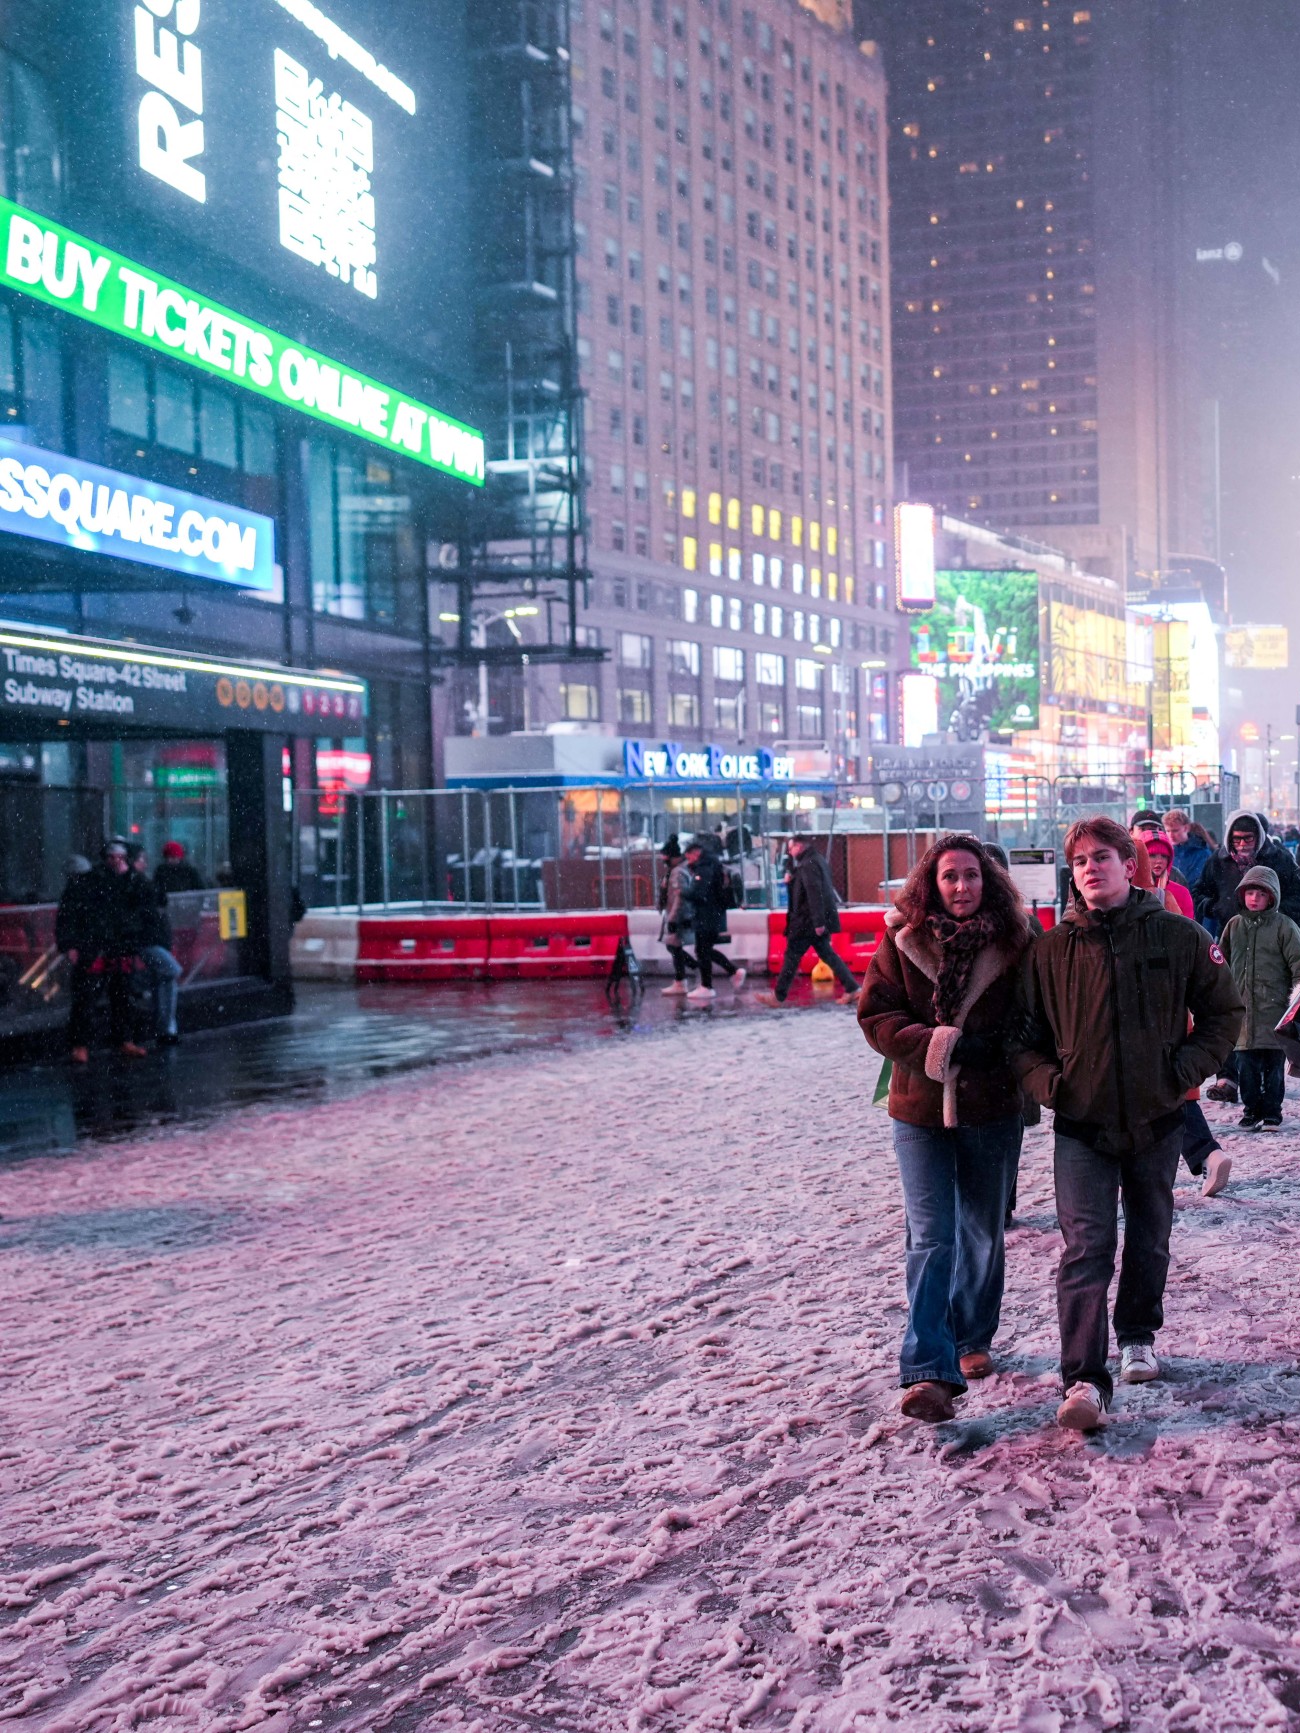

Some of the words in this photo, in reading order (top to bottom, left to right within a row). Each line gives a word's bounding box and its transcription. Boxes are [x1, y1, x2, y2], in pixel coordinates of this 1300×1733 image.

[6, 214, 111, 310] BUY
[118, 267, 273, 388] TICKETS
[279, 348, 391, 431] ONLINE
[391, 400, 428, 453] AT
[0, 457, 257, 571] SSQUARE.COM
[3, 647, 58, 679] Times
[59, 654, 142, 688] Square-42
[142, 666, 188, 692] Street
[4, 678, 73, 713] Subway
[76, 686, 135, 713] Station
[624, 739, 667, 777] NEW
[663, 741, 710, 779] YORK
[710, 743, 759, 780] POLICE
[759, 746, 796, 780] DEPT
